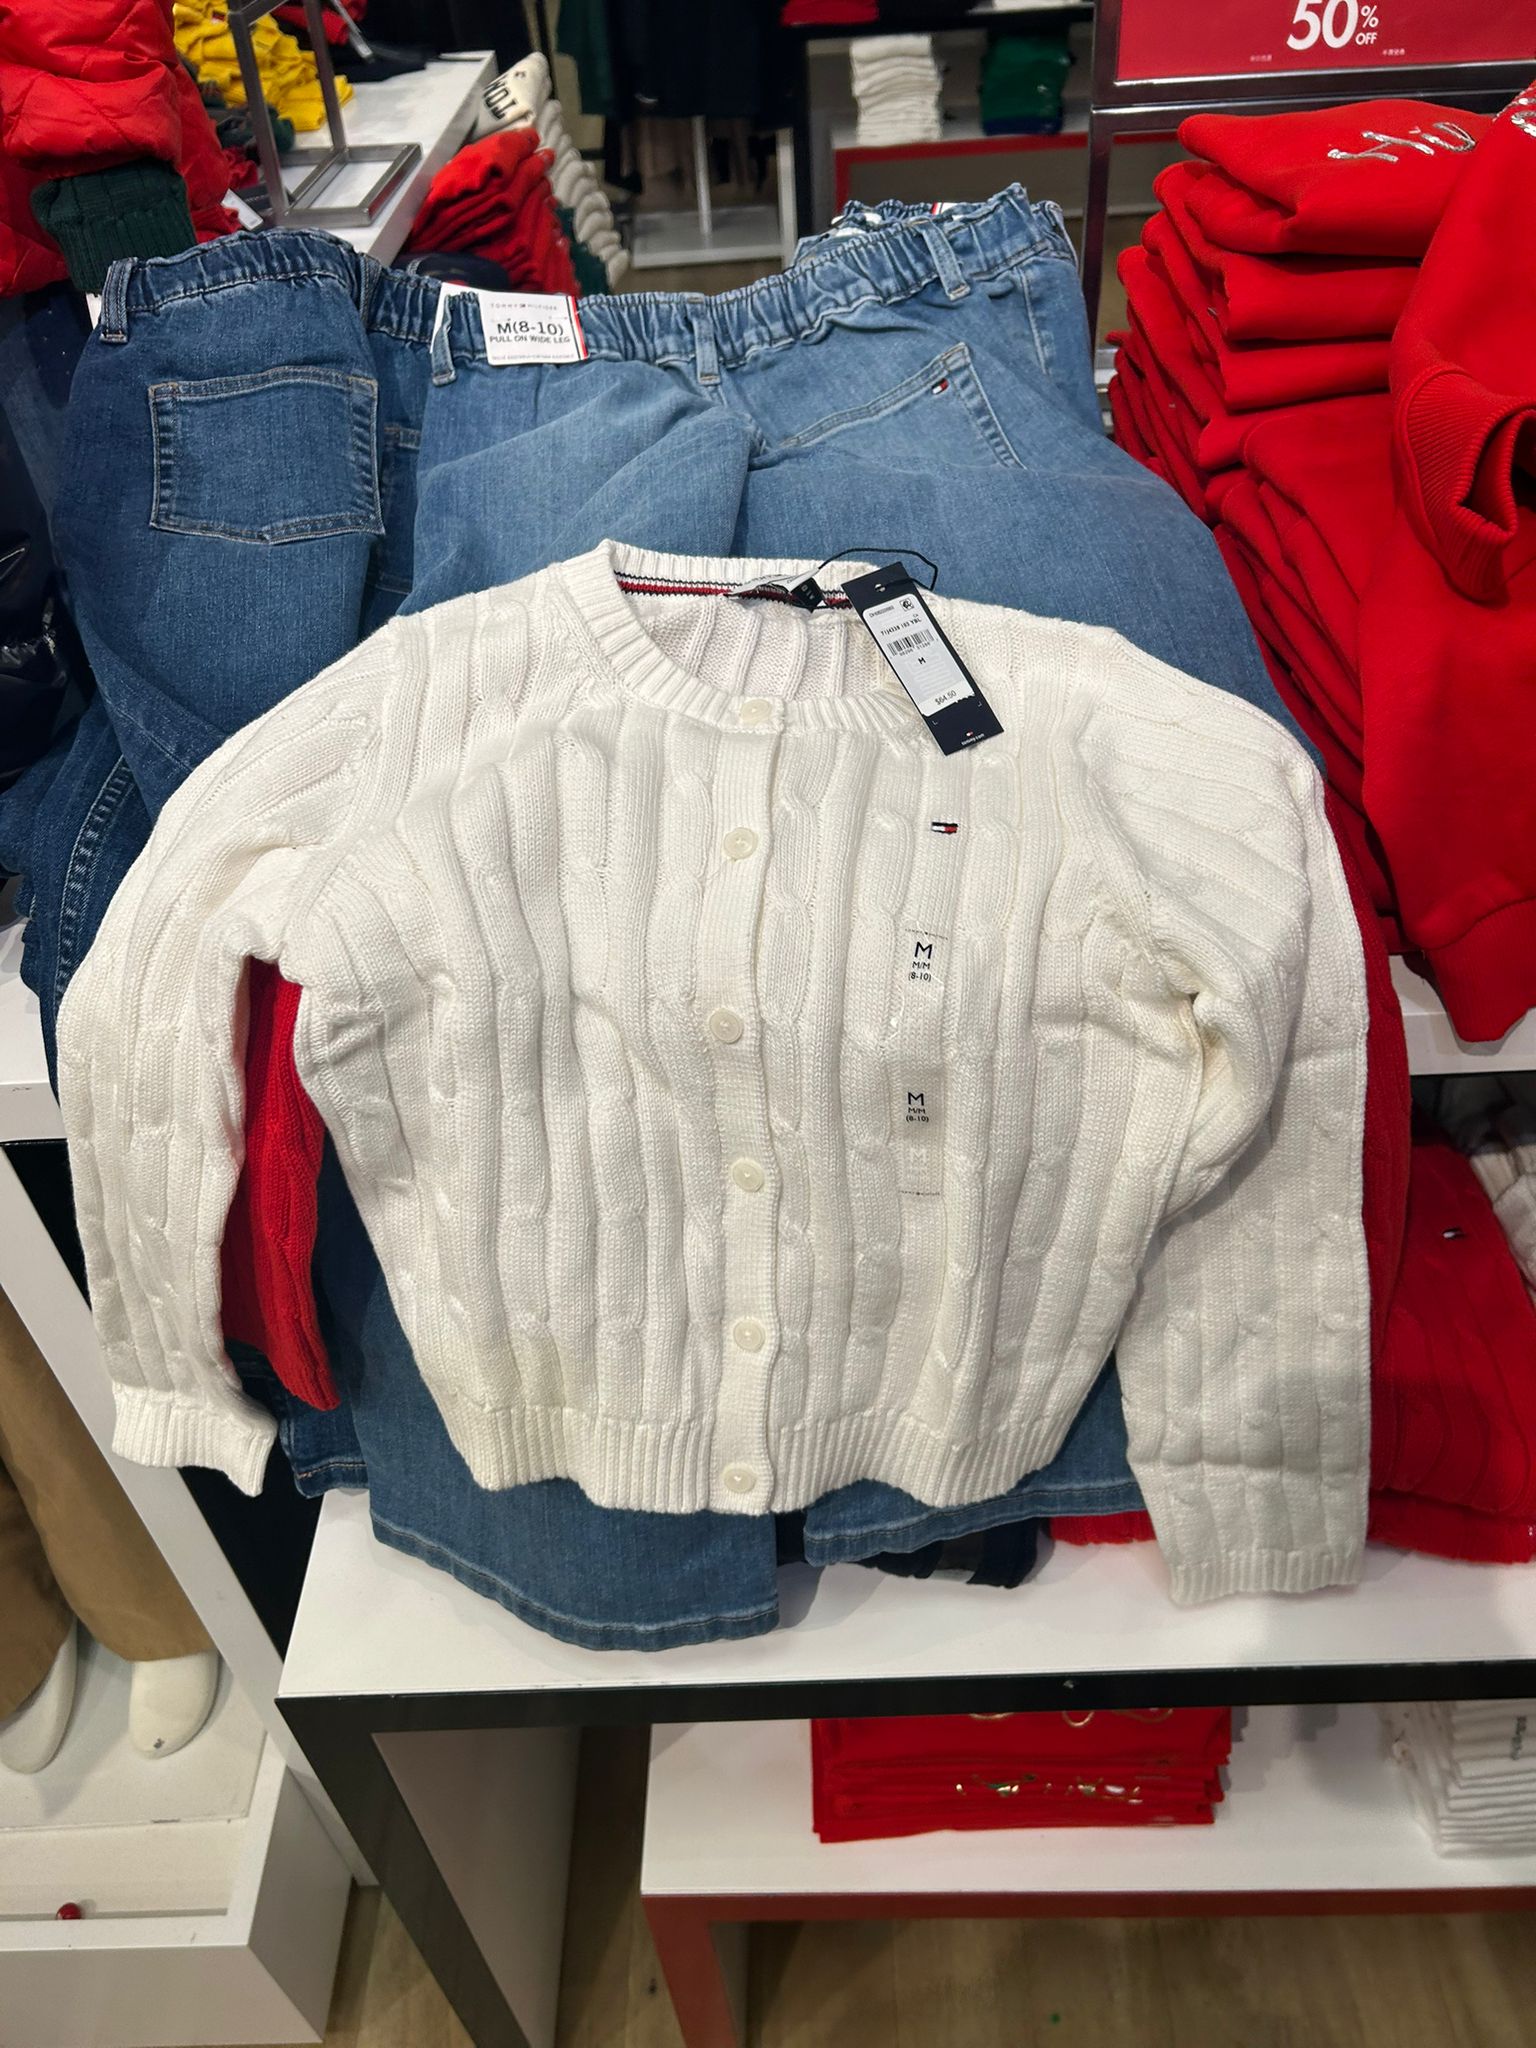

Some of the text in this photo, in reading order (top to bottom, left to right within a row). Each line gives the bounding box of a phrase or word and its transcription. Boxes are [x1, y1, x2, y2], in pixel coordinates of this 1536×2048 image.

[1356, 32, 1378, 45] OFF
[530, 335, 552, 344] WIDE
[553, 335, 571, 344] LEG
[917, 656, 926, 665] M
[934, 689, 957, 706] $64.50
[914, 941, 933, 959] M
[912, 961, 931, 970] M/M
[908, 971, 932, 982] (8-10)
[907, 1092, 925, 1106] M
[908, 1107, 926, 1115] M/M
[905, 1115, 930, 1123] (8-10)
